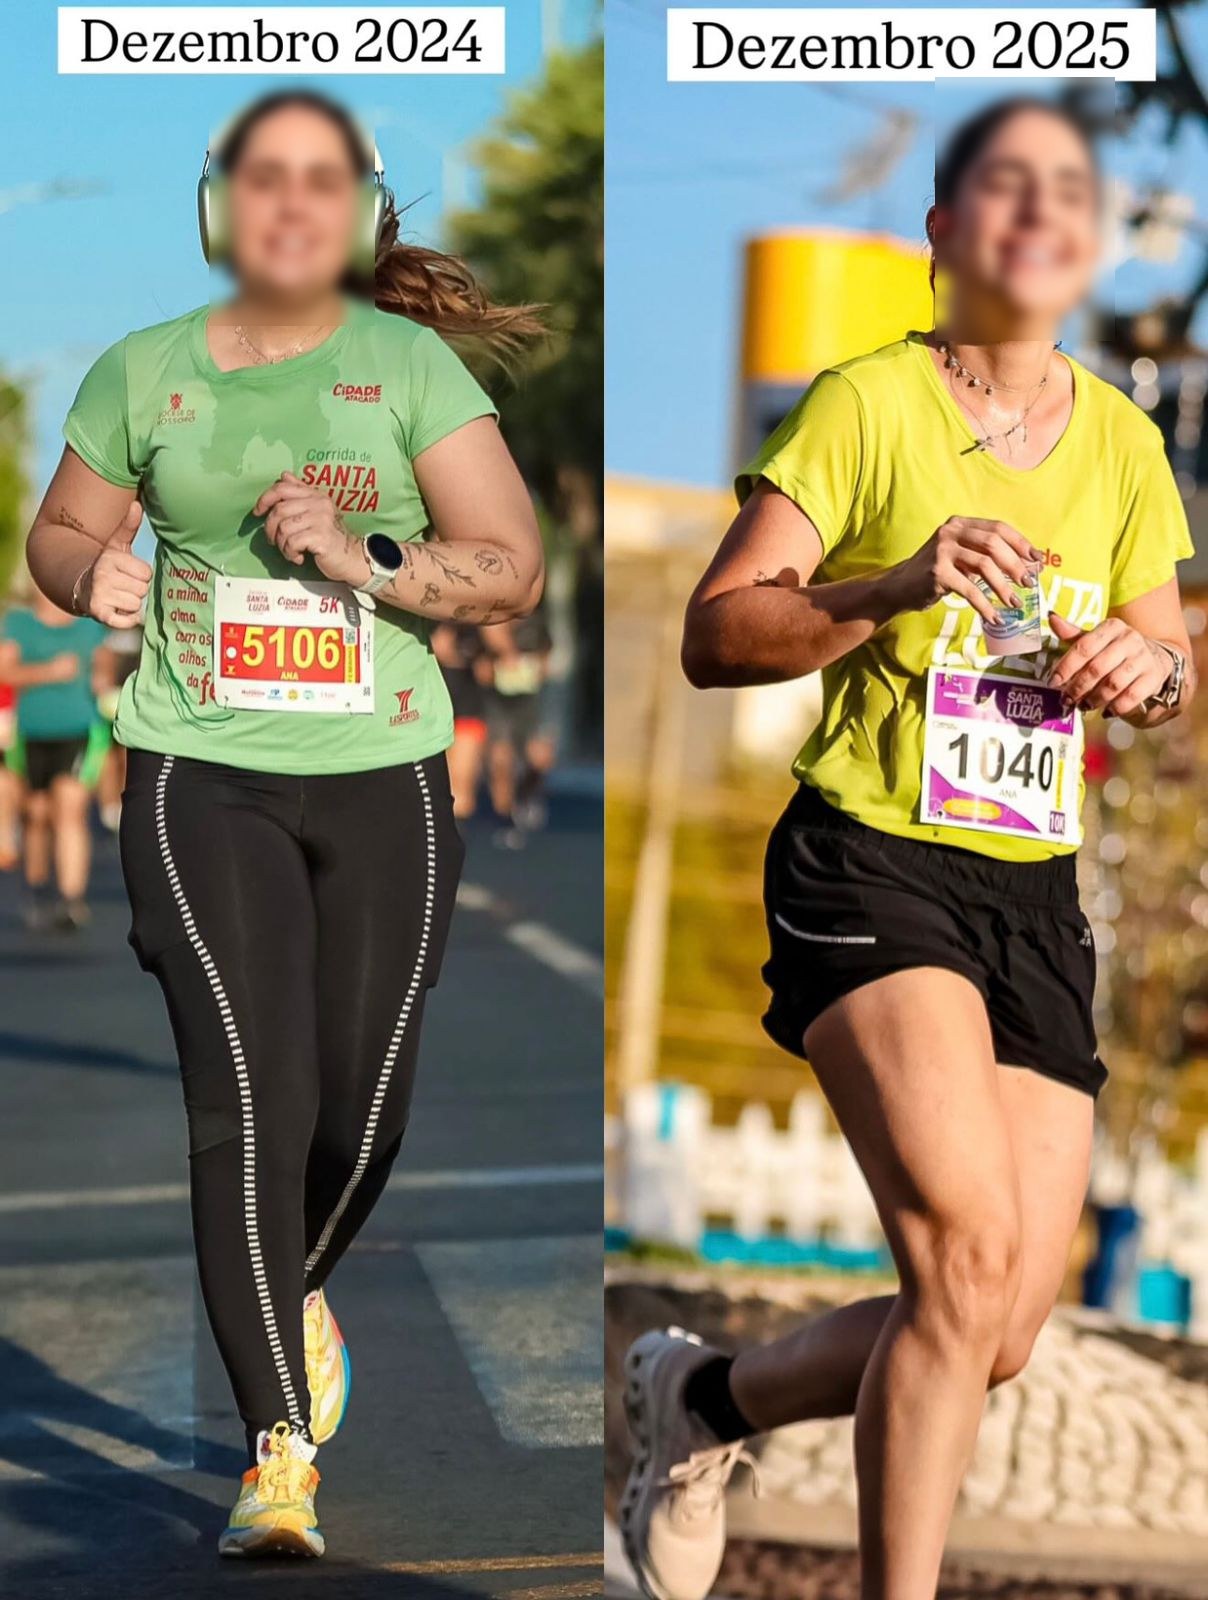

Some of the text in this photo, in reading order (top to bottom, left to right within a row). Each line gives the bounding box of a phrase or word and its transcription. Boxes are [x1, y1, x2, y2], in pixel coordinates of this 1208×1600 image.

[345, 395, 381, 403] ATACADO
[306, 448, 372, 462] Corrida de
[302, 464, 376, 489] SANTA
[167, 586, 208, 603] a minha
[319, 596, 341, 613] 5K
[170, 608, 196, 623] alma
[199, 634, 212, 646] os
[242, 626, 340, 669] 5106
[178, 650, 207, 667] olhos
[187, 672, 199, 688] da
[280, 671, 299, 681] ANA
[1007, 691, 1043, 706] SANTA
[949, 733, 1053, 791] 1040
